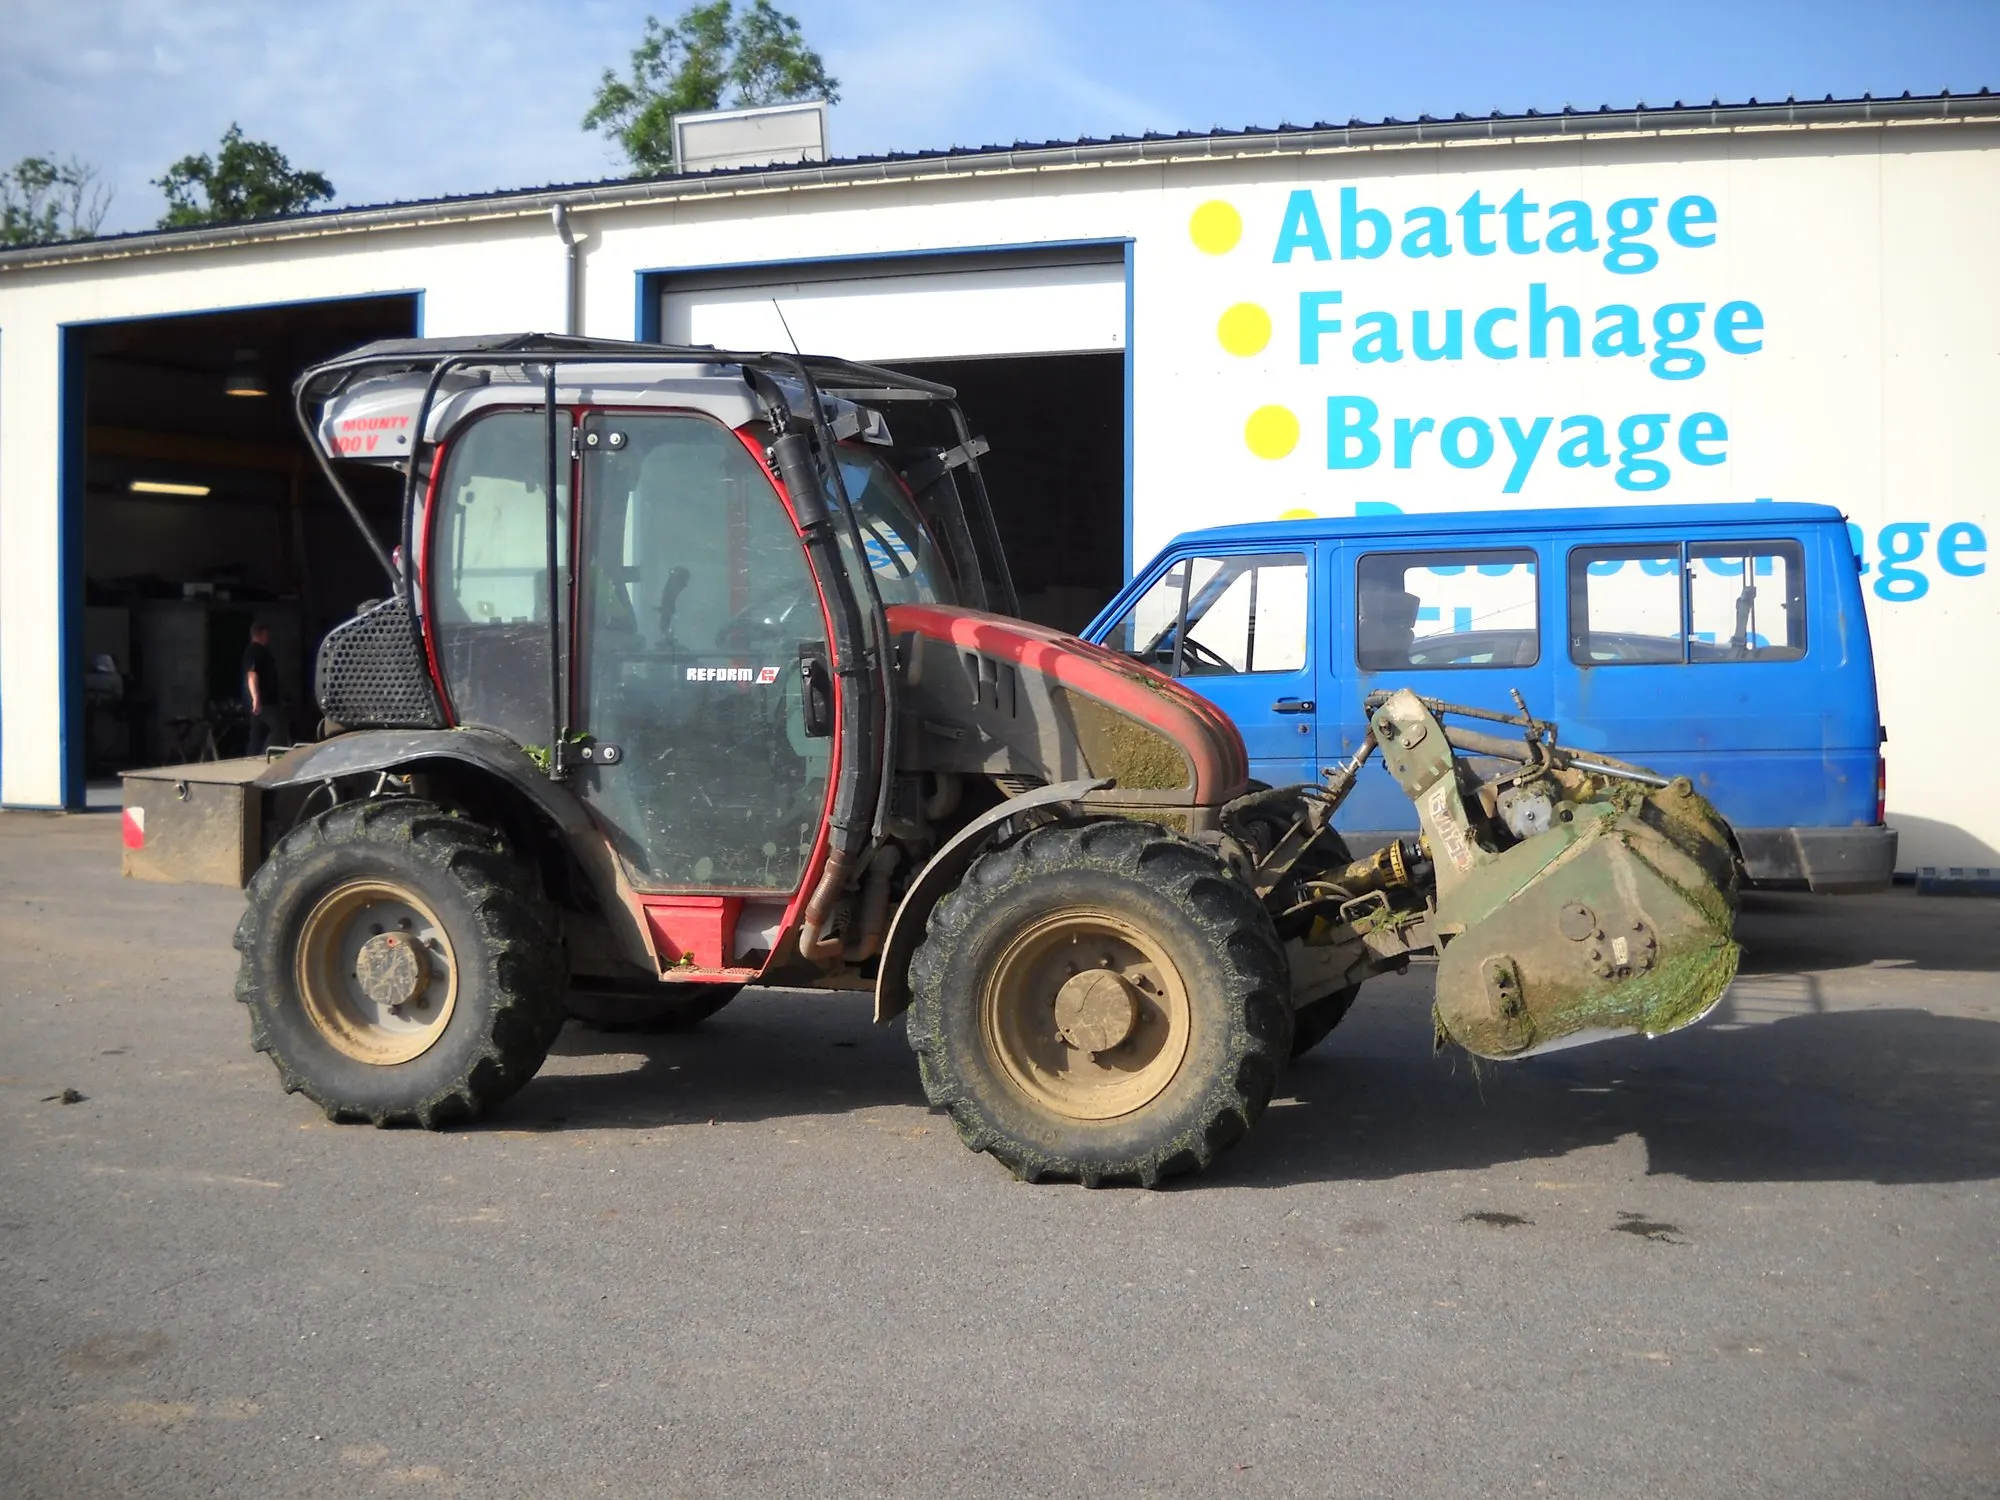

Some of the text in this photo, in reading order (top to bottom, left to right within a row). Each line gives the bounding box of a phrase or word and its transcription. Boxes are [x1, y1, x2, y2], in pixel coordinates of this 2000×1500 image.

[1273, 187, 1718, 275] Abattage
[1299, 283, 1765, 381] Fauchage
[342, 416, 409, 431] MOUNTY
[366, 435, 379, 452] V
[1326, 396, 1729, 494] Broyage
[686, 667, 753, 682] REFORM
